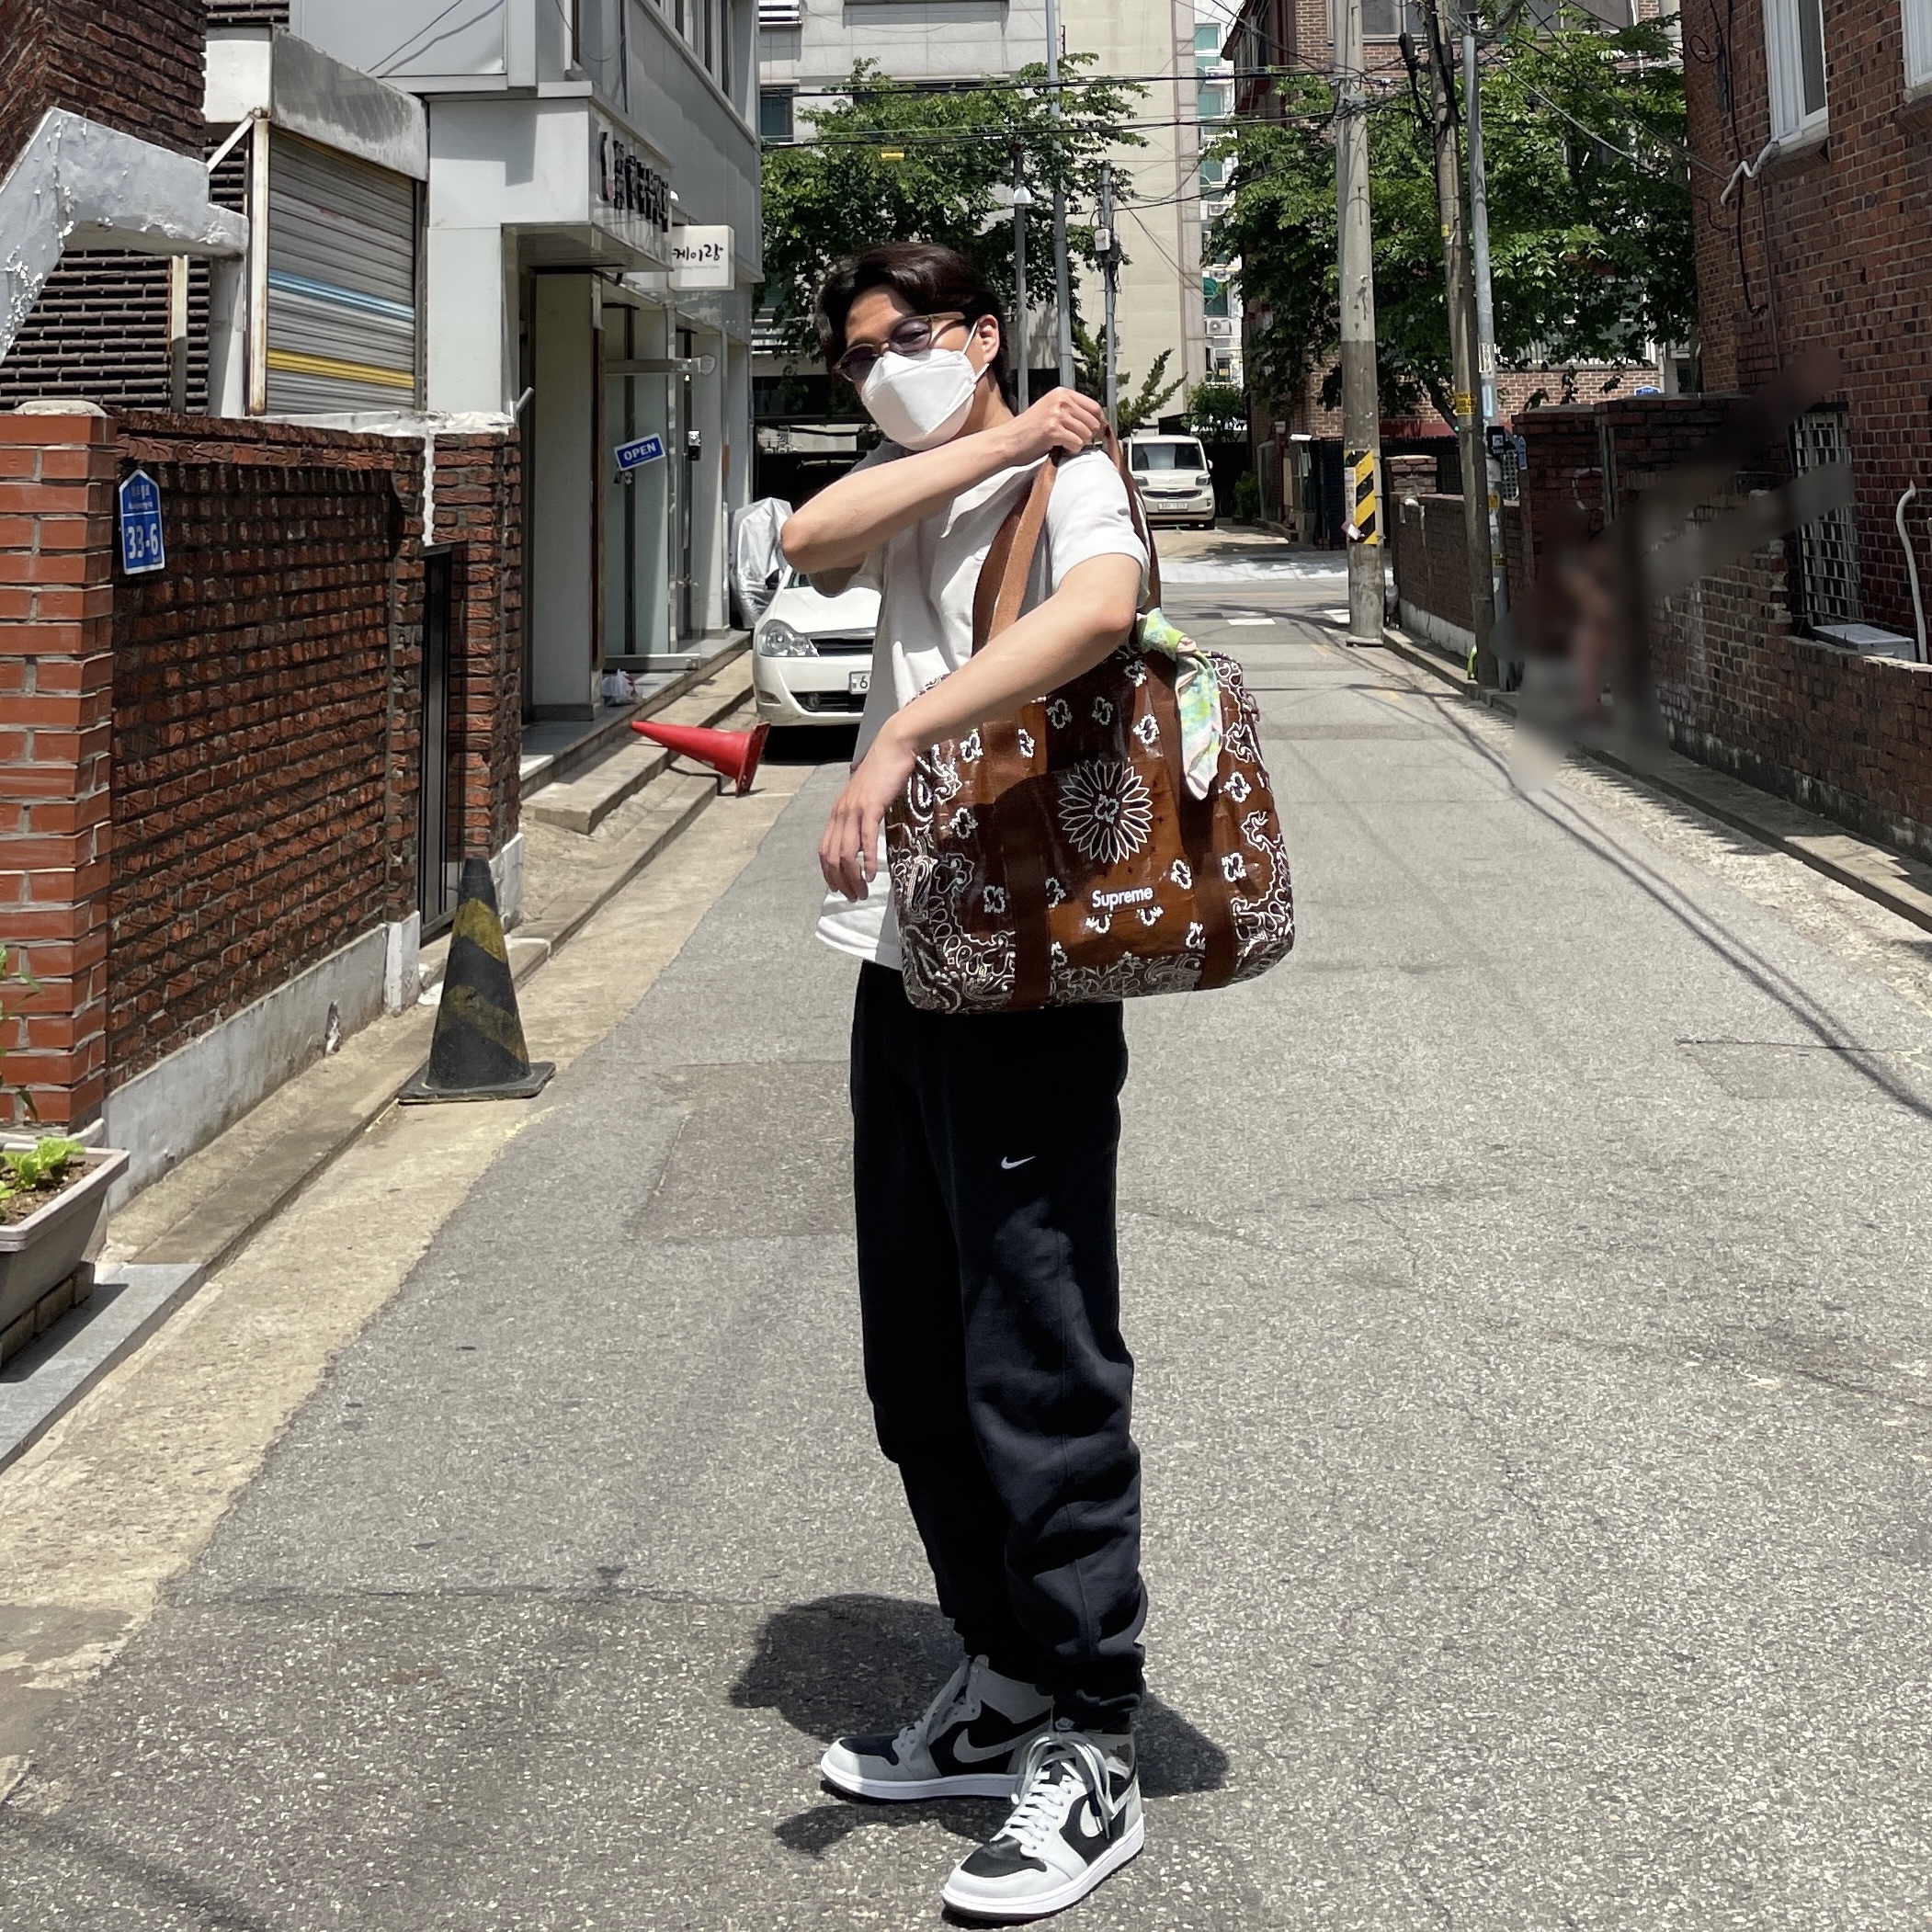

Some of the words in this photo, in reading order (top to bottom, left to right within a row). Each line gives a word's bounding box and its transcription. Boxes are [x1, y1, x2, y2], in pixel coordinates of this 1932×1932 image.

[624, 442, 656, 460] OPEN
[126, 523, 159, 559] 33-6
[860, 676, 868, 688] 6
[1092, 887, 1154, 911] Supreme
